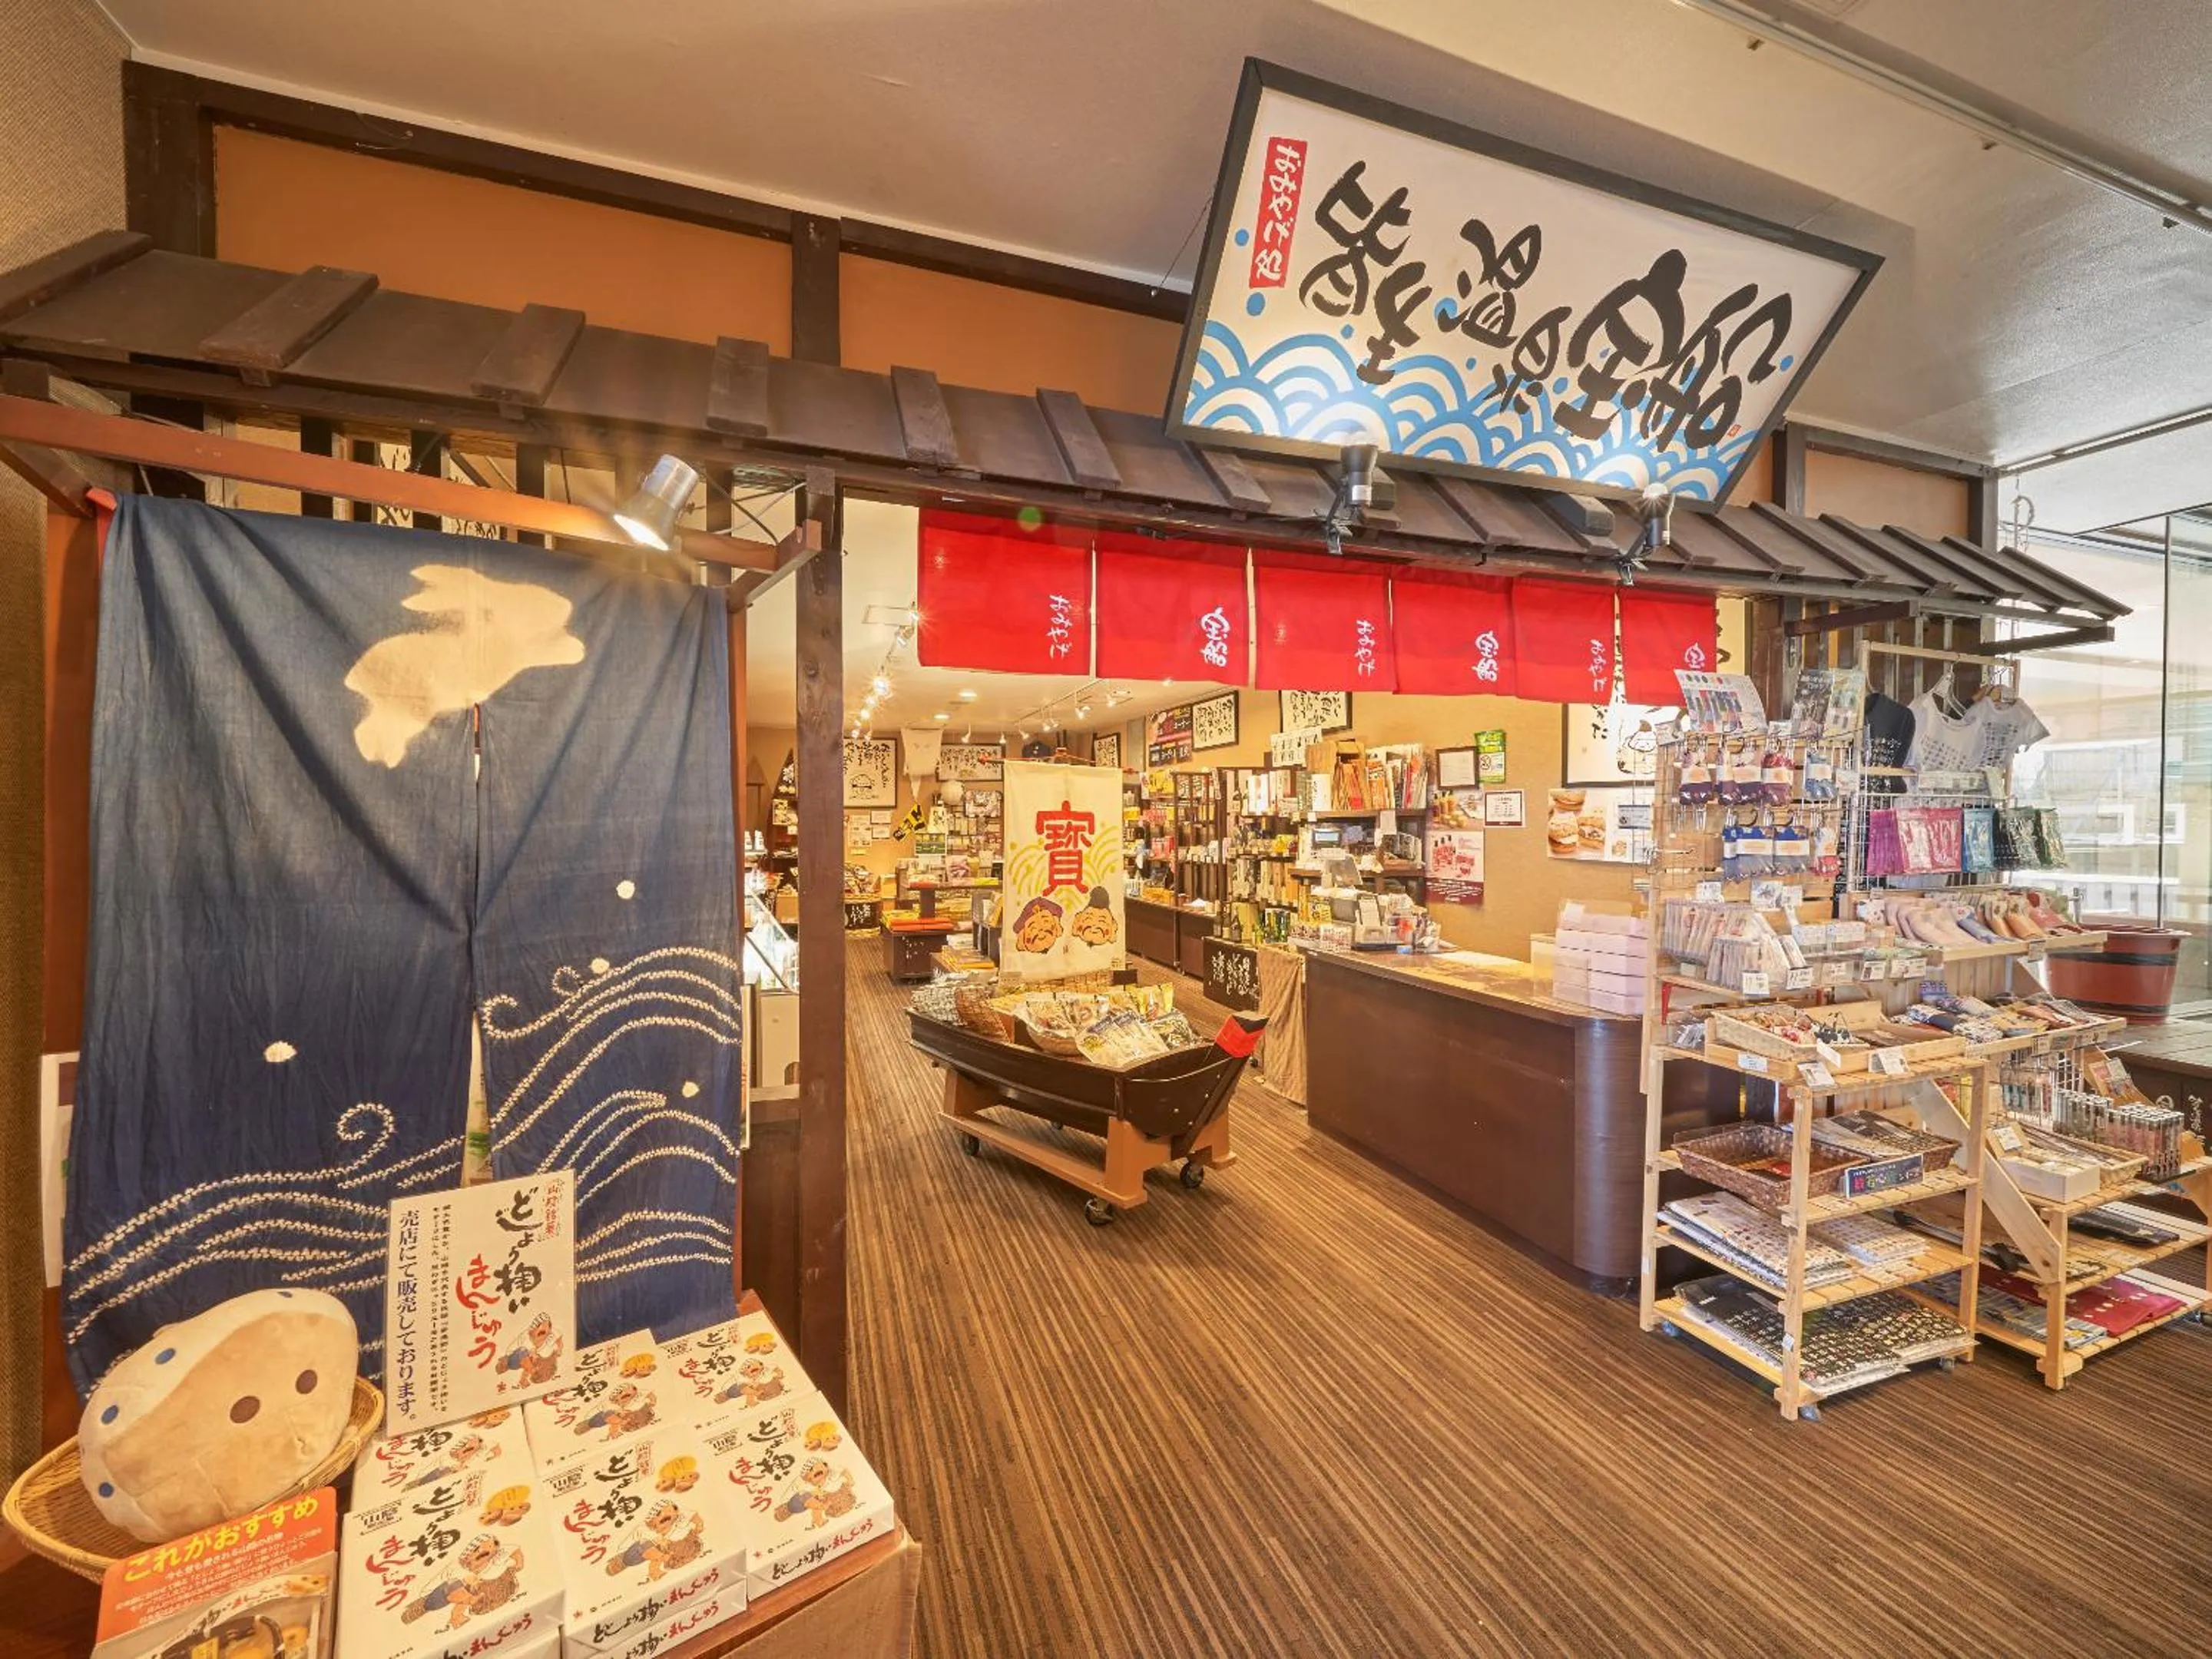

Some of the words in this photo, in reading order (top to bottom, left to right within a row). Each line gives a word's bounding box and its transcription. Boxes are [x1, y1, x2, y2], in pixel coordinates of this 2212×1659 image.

[1254, 144, 1301, 280] おみやげ処
[455, 1253, 502, 1369] まんじゅう
[494, 1187, 544, 1314] どじょう掬い
[396, 1210, 419, 1420] 売店にて販売しております。
[124, 1495, 319, 1582] これがおすすめ
